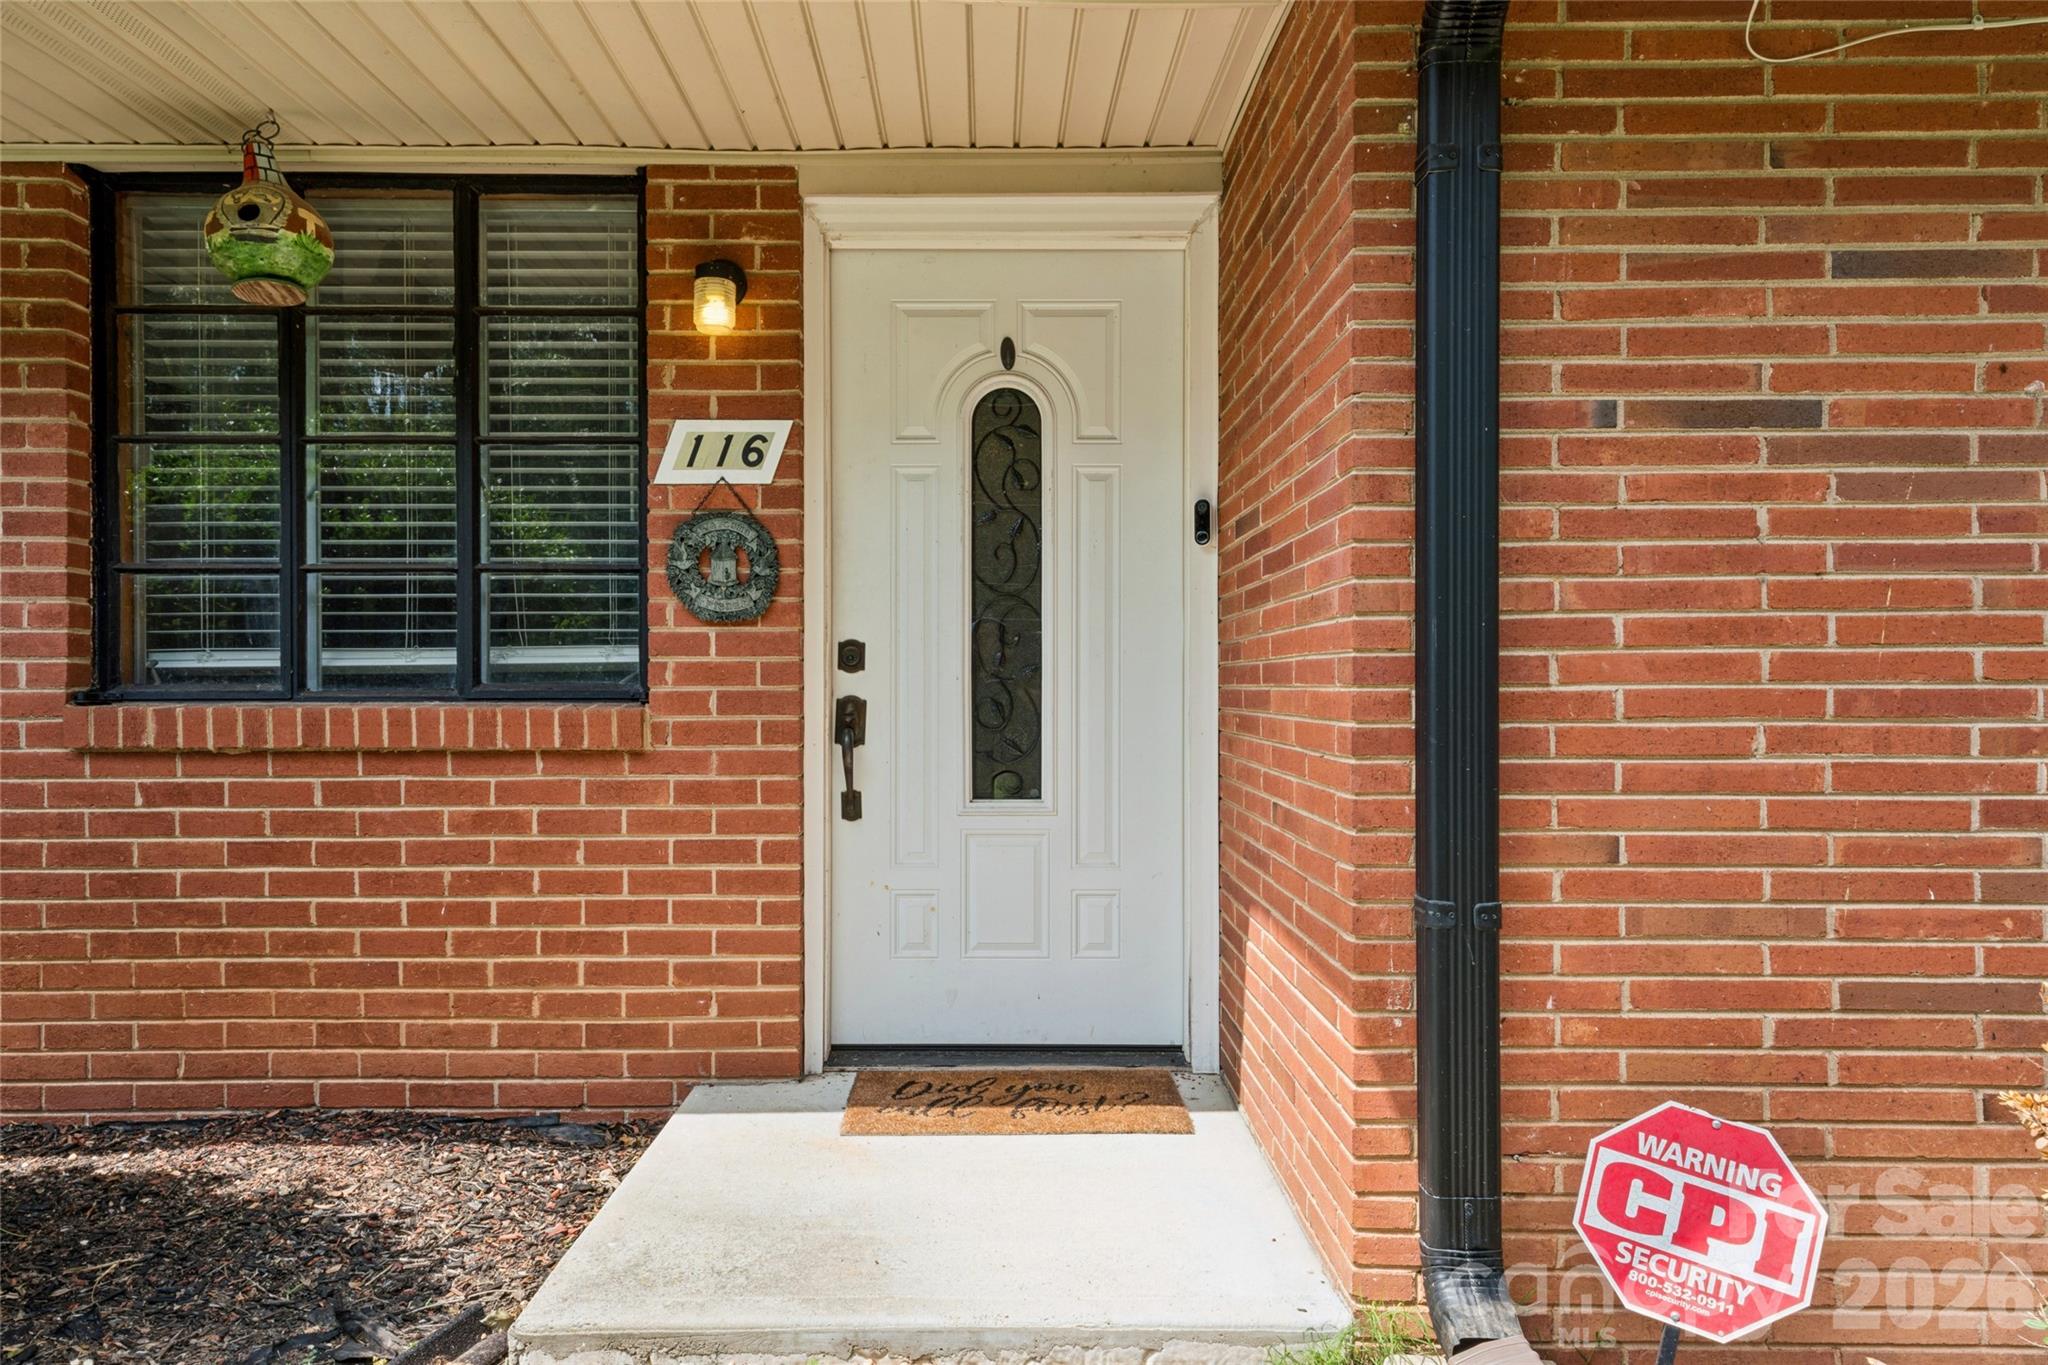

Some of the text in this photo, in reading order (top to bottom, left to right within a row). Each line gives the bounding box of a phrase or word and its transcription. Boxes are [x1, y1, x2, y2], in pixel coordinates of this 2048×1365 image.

[686, 434, 769, 468] 116
[1638, 1132, 1782, 1198] WARNING
[1597, 1161, 1806, 1286] CPI
[1615, 1241, 1755, 1306] SECURITY
[1628, 1269, 1734, 1316] 800-532-0911
